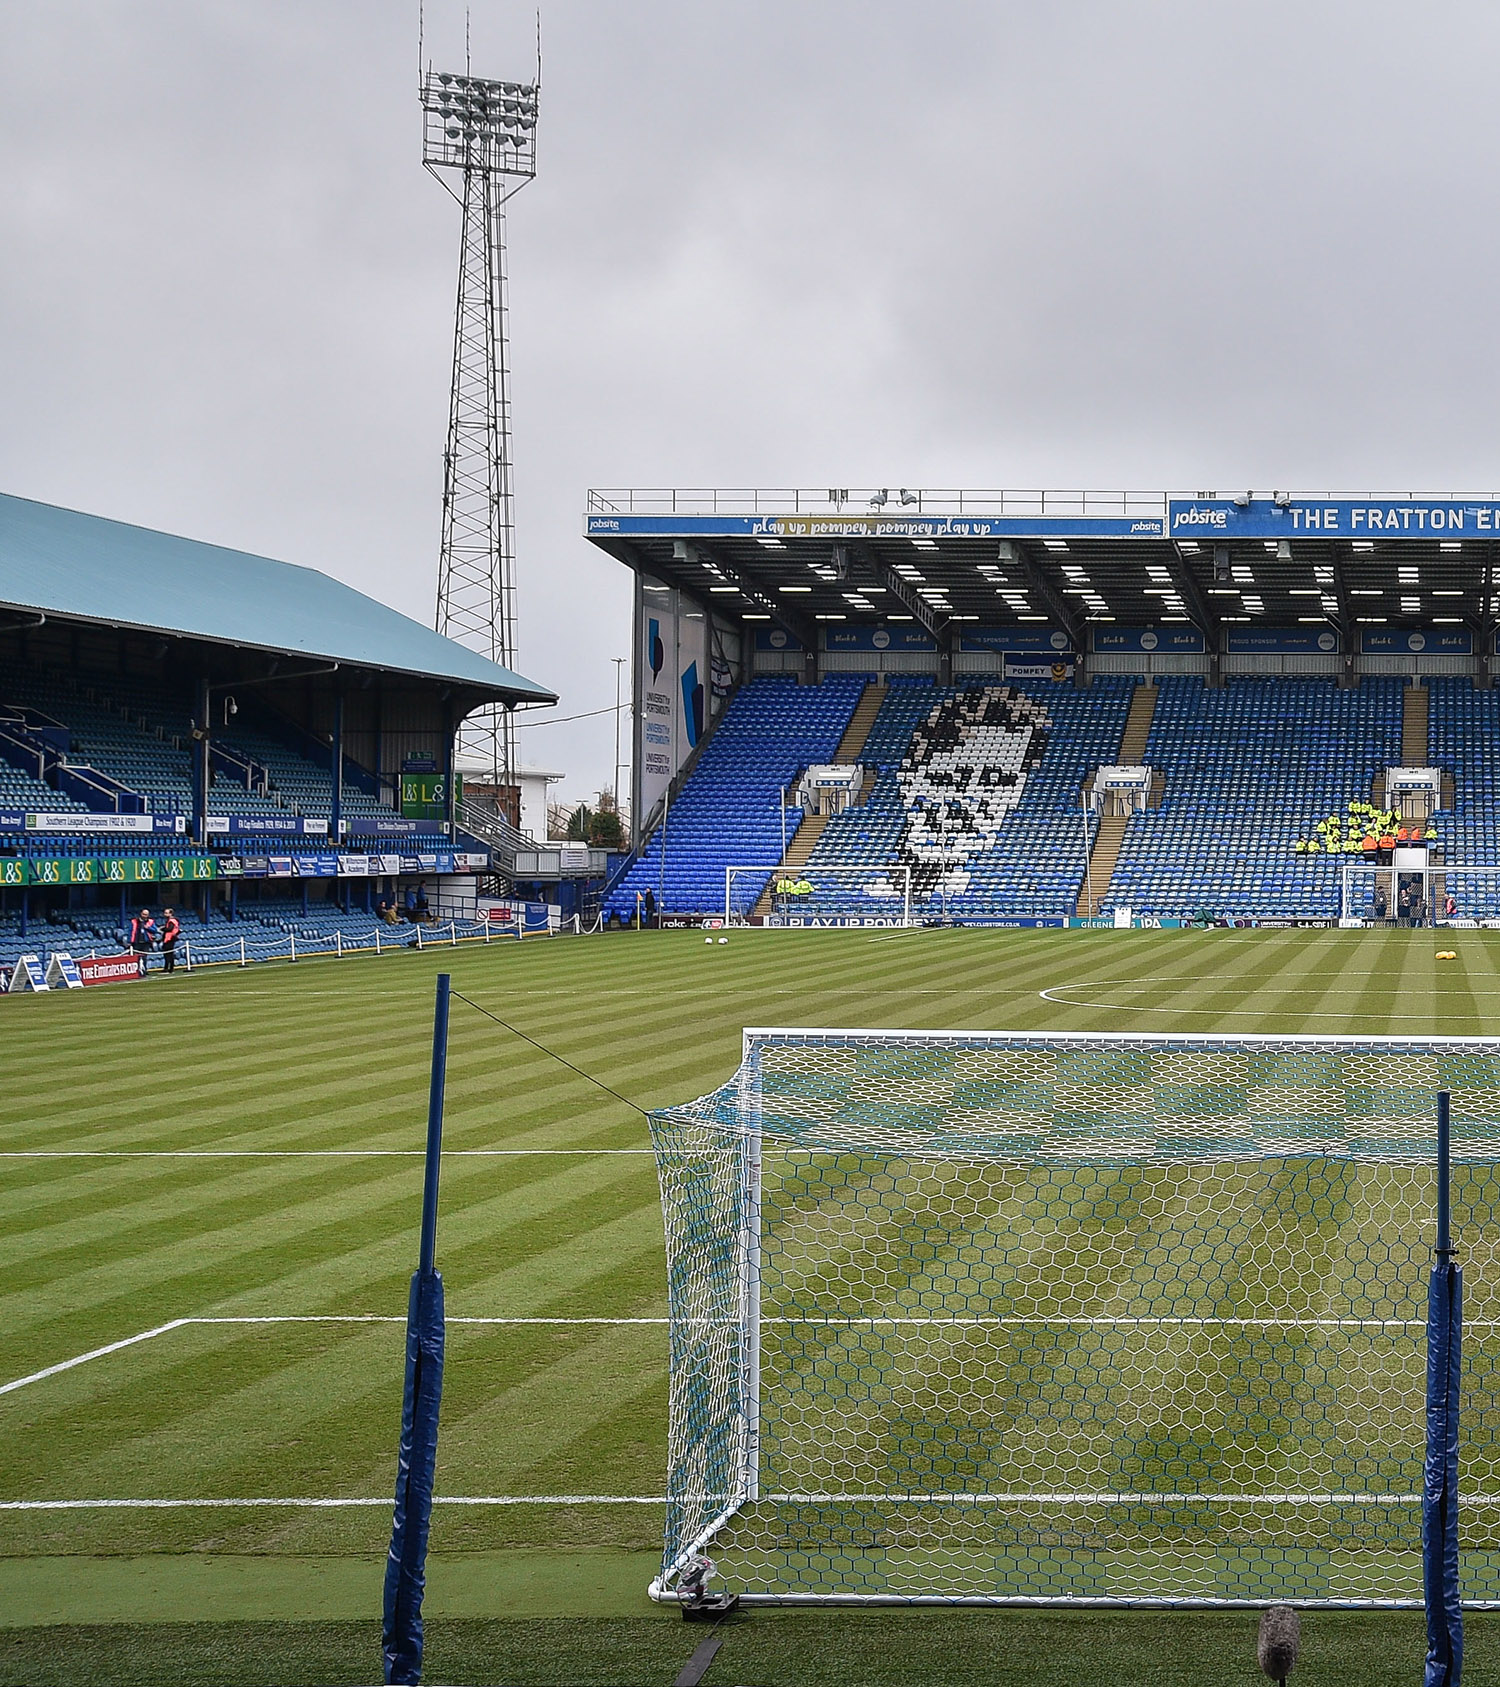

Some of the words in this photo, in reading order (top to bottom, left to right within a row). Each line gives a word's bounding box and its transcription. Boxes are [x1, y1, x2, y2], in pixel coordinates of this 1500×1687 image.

[590, 519, 619, 531] jobsite
[1173, 509, 1226, 529] jobsite
[1289, 508, 1338, 529] THE
[1352, 508, 1464, 529] FRATTON
[752, 517, 785, 535] play
[789, 523, 806, 535] up
[810, 522, 871, 535] pompey,
[876, 522, 932, 535] pompey
[936, 518, 969, 536] play
[973, 523, 990, 536] up
[1130, 521, 1160, 532] jobsite
[46, 816, 66, 826] Southern
[66, 817, 84, 828] League
[84, 817, 108, 828] Champions
[37, 861, 59, 882] L&S
[71, 860, 92, 882] L&S
[104, 860, 125, 881] L&S
[135, 860, 154, 881] L&S
[166, 859, 184, 880] L&S
[194, 859, 211, 879] L&S
[790, 918, 830, 927] PLAY
[834, 918, 859, 927] UP
[1141, 920, 1162, 928] IPA
[82, 967, 94, 980] THE
[94, 963, 120, 979] Emirates
[120, 965, 127, 975] FA
[127, 962, 138, 974] CUP
